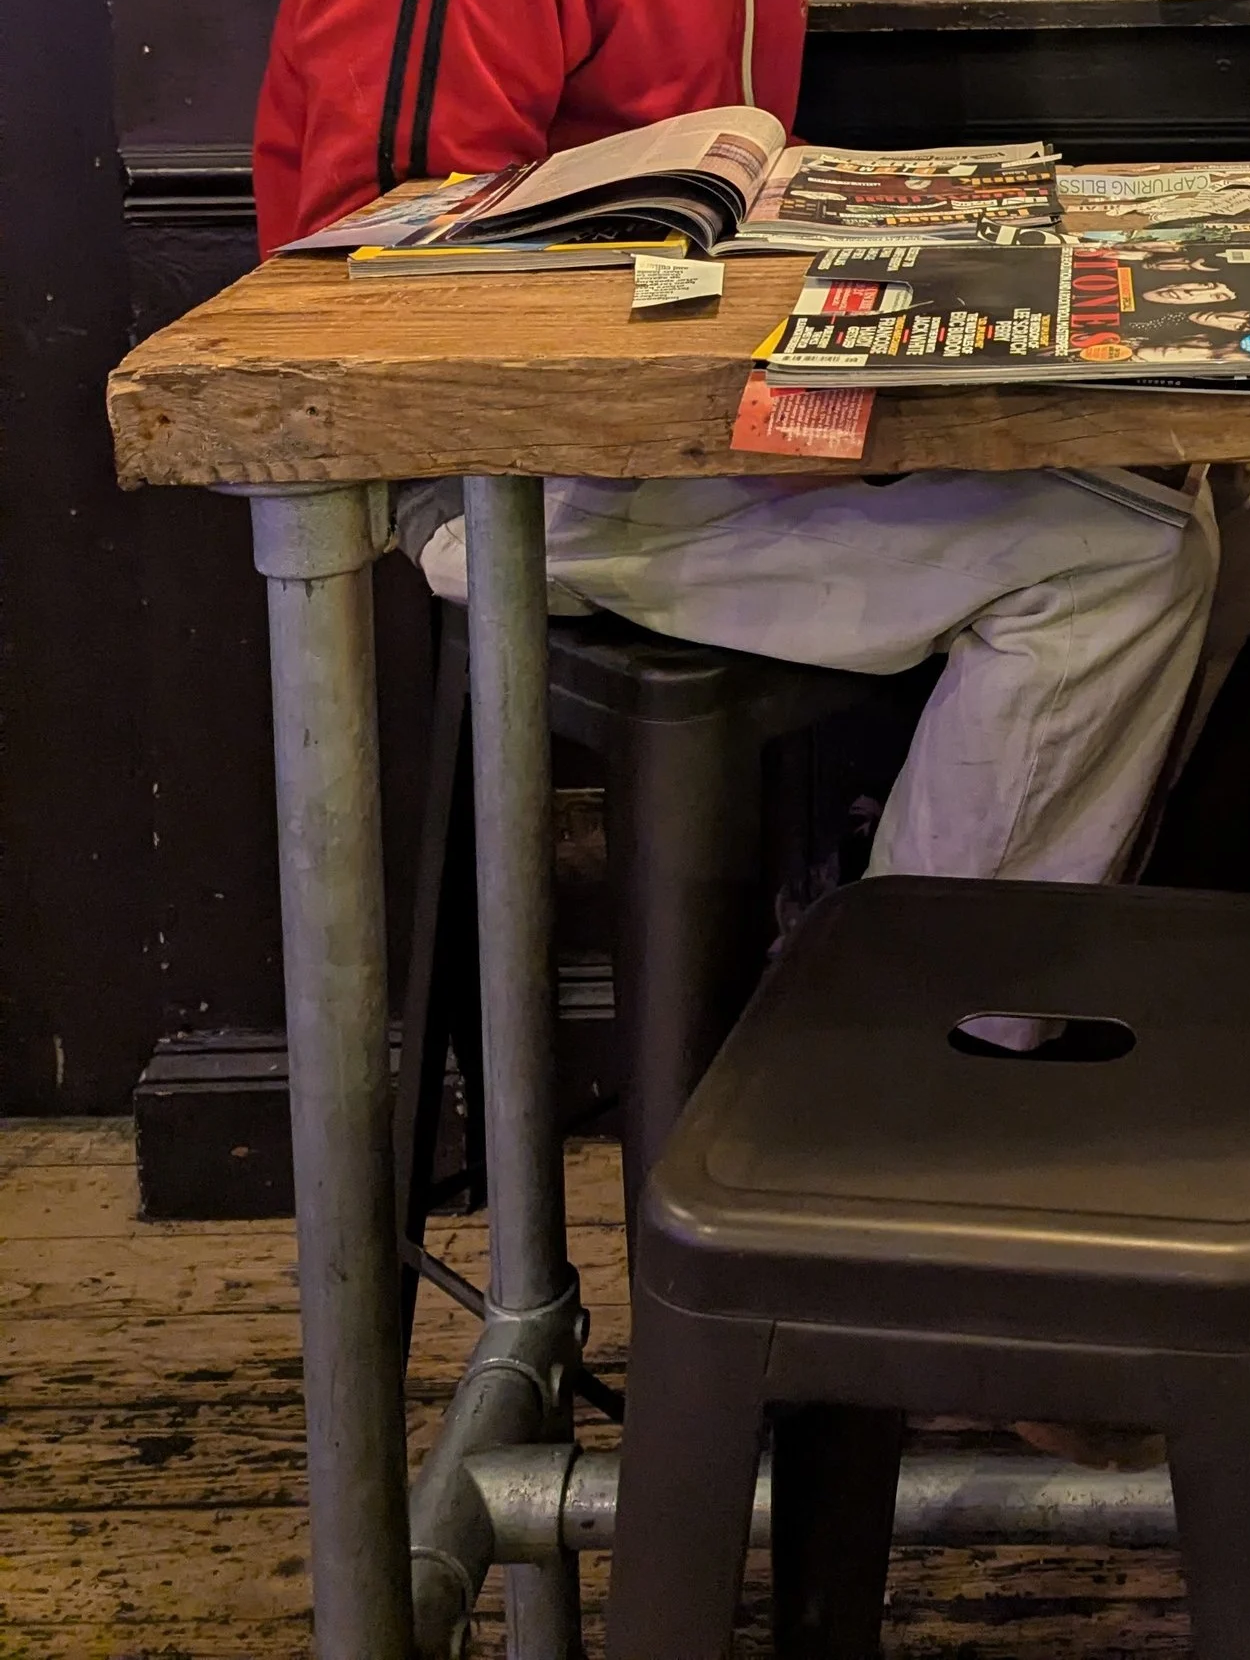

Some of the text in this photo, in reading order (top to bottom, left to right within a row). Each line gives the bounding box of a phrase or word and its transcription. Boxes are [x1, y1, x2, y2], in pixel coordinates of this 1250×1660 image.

[1059, 175, 1210, 198] CAPTURING BLISS
[906, 315, 930, 355] JACK WHITE
[942, 312, 968, 357] ERIC BURDON
